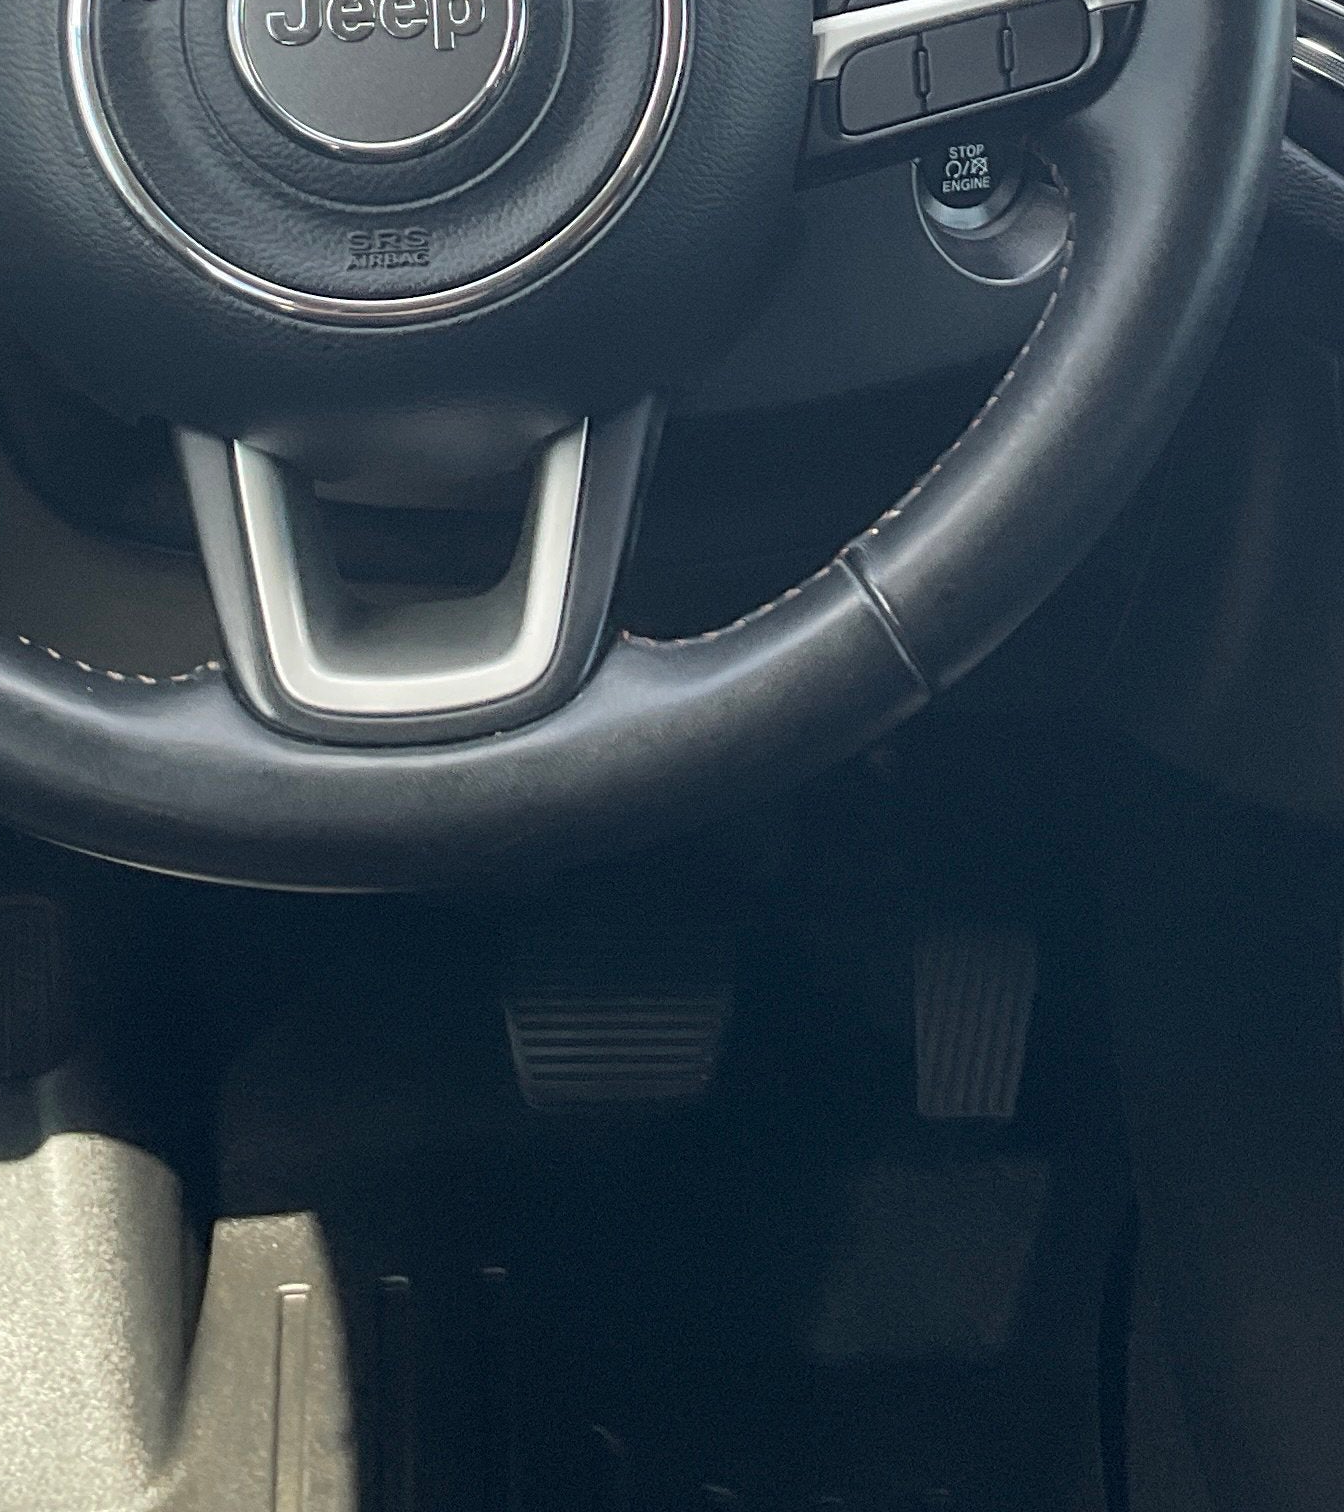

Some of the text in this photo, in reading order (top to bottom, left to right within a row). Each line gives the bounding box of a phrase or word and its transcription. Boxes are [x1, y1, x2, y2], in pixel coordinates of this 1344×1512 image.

[948, 144, 985, 160] STOP
[942, 175, 991, 193] ENGINE
[346, 228, 431, 250] SRS
